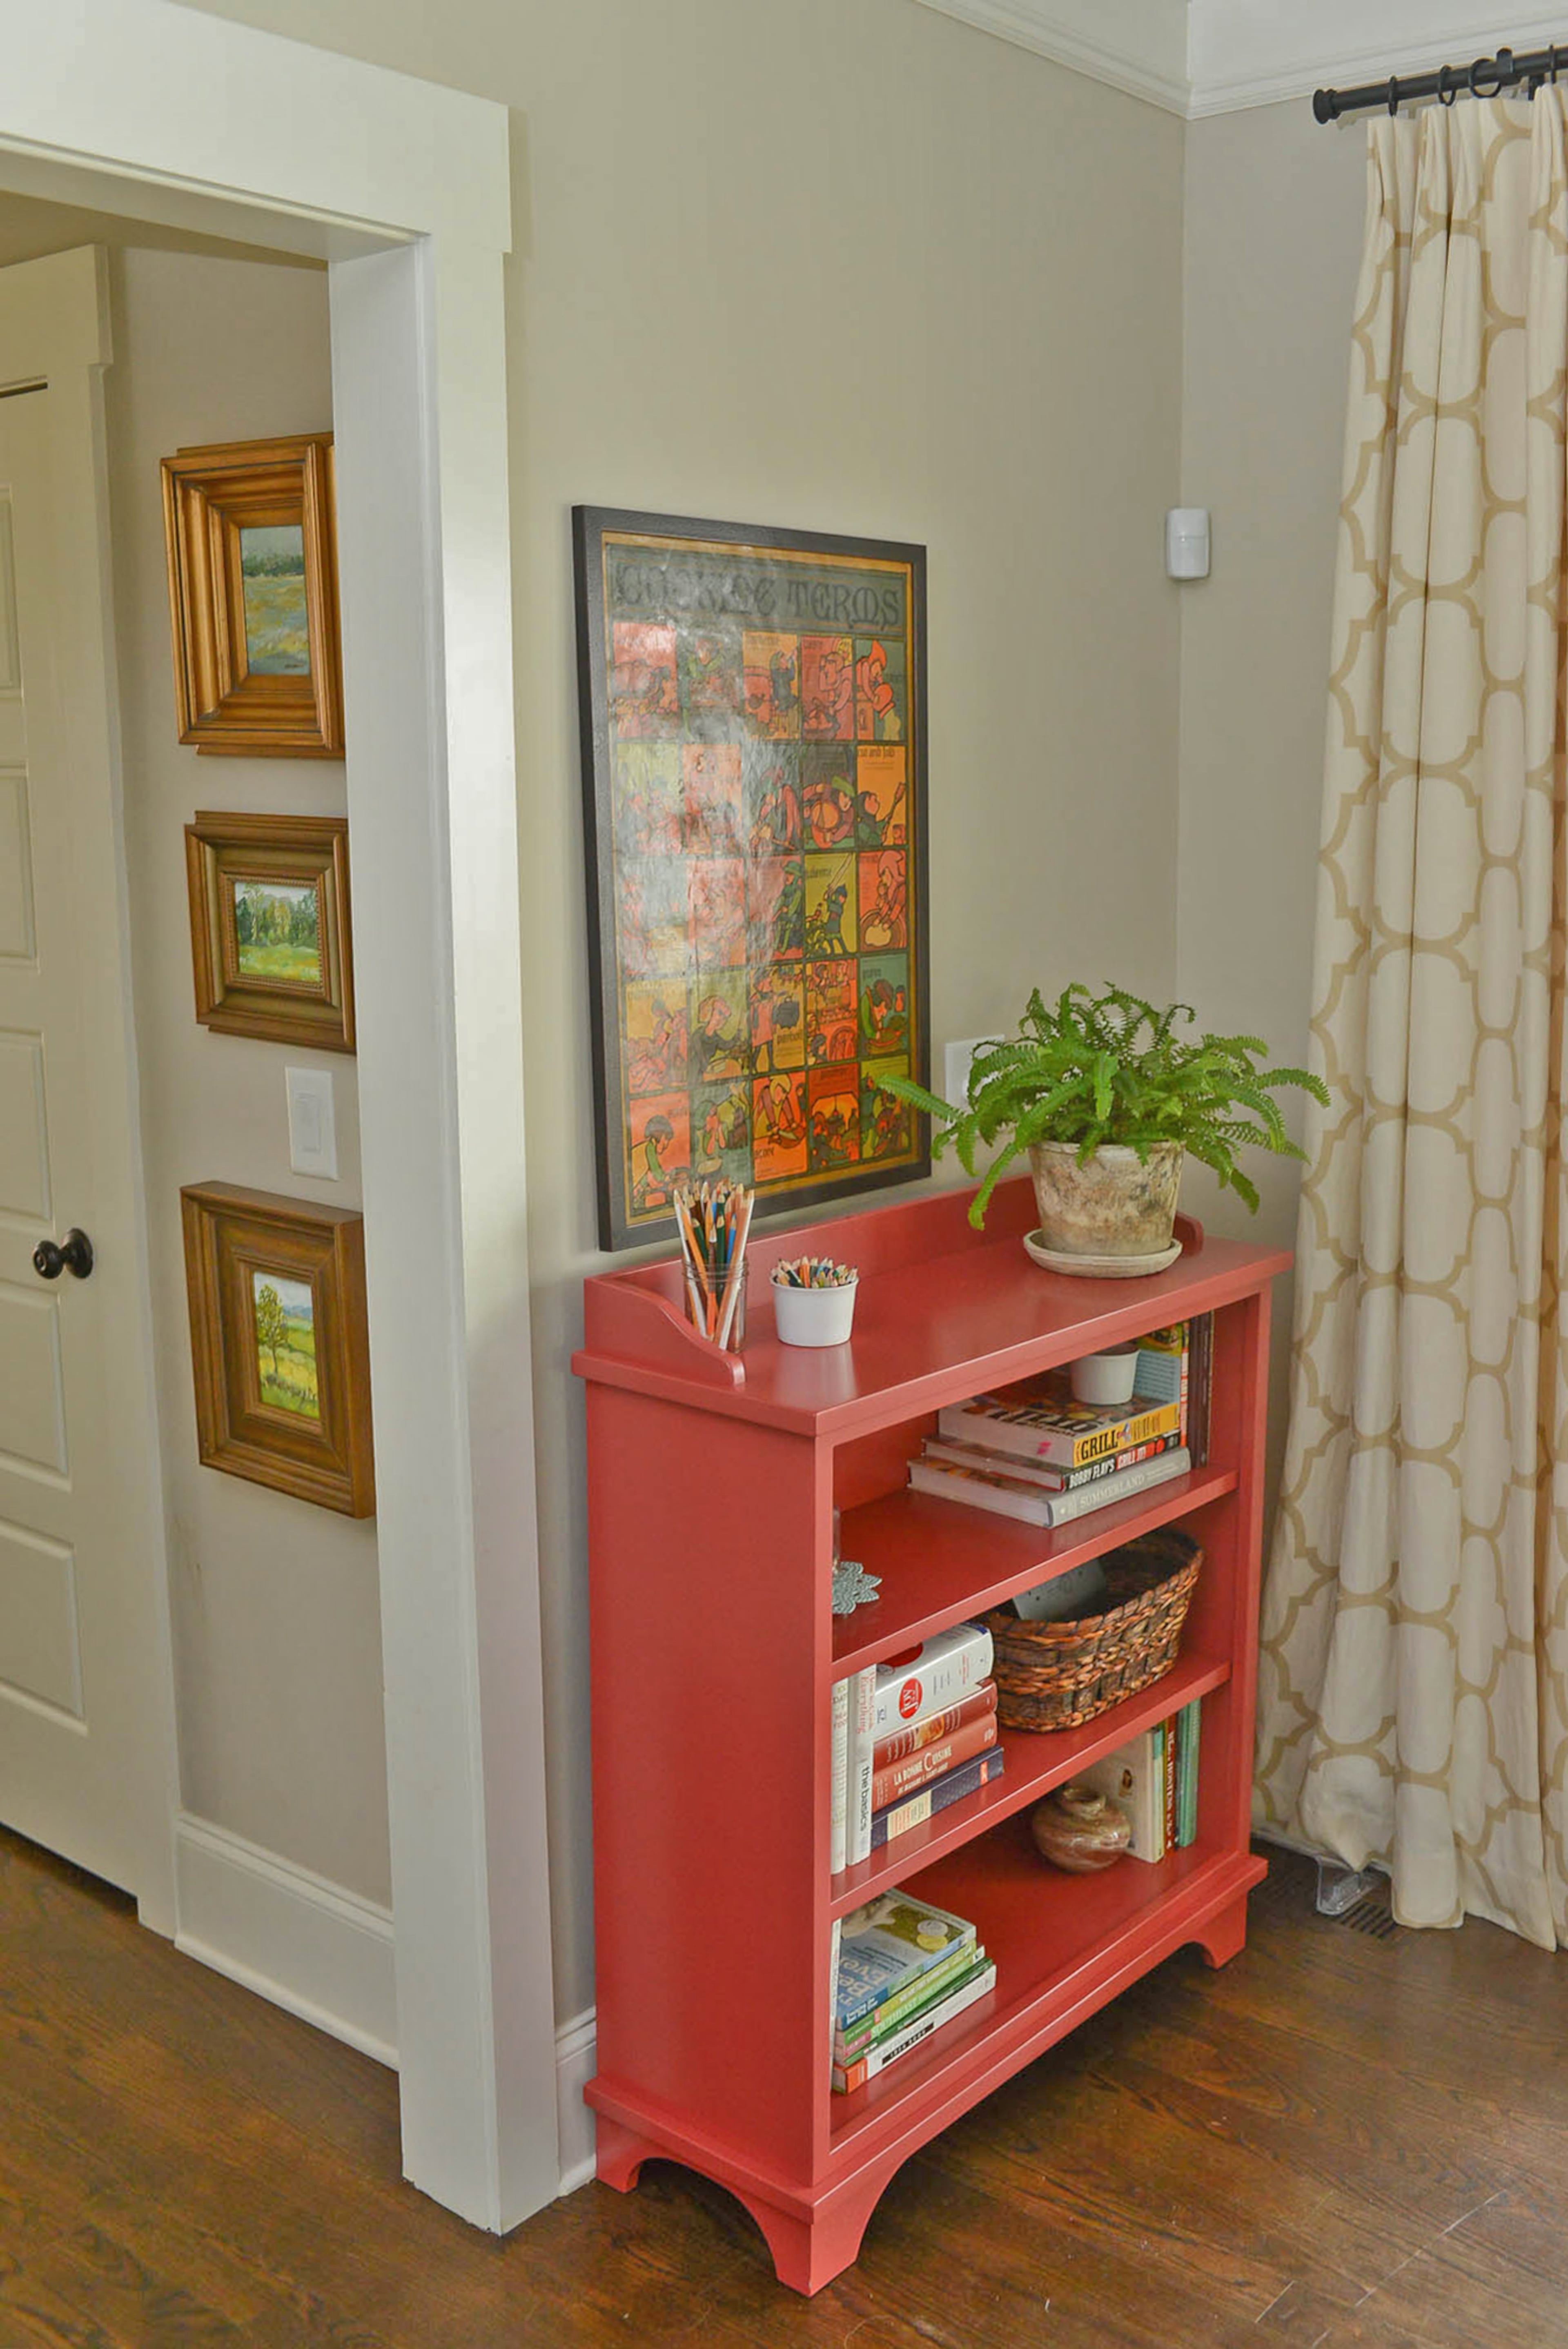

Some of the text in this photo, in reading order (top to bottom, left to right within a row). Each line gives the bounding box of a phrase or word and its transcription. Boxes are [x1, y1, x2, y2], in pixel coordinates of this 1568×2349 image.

[787, 579, 900, 631] TERMS
[1081, 1429, 1118, 1461] GRILL
[1069, 1467, 1092, 1490] BOBBY
[1092, 1458, 1115, 1480] FLAY'S
[1079, 1474, 1145, 1509] SUMMERLAND
[893, 1771, 902, 1786] LA
[902, 1760, 923, 1781] BONNE
[924, 1744, 952, 1772] CUISINE
[860, 1788, 870, 1832] basics
